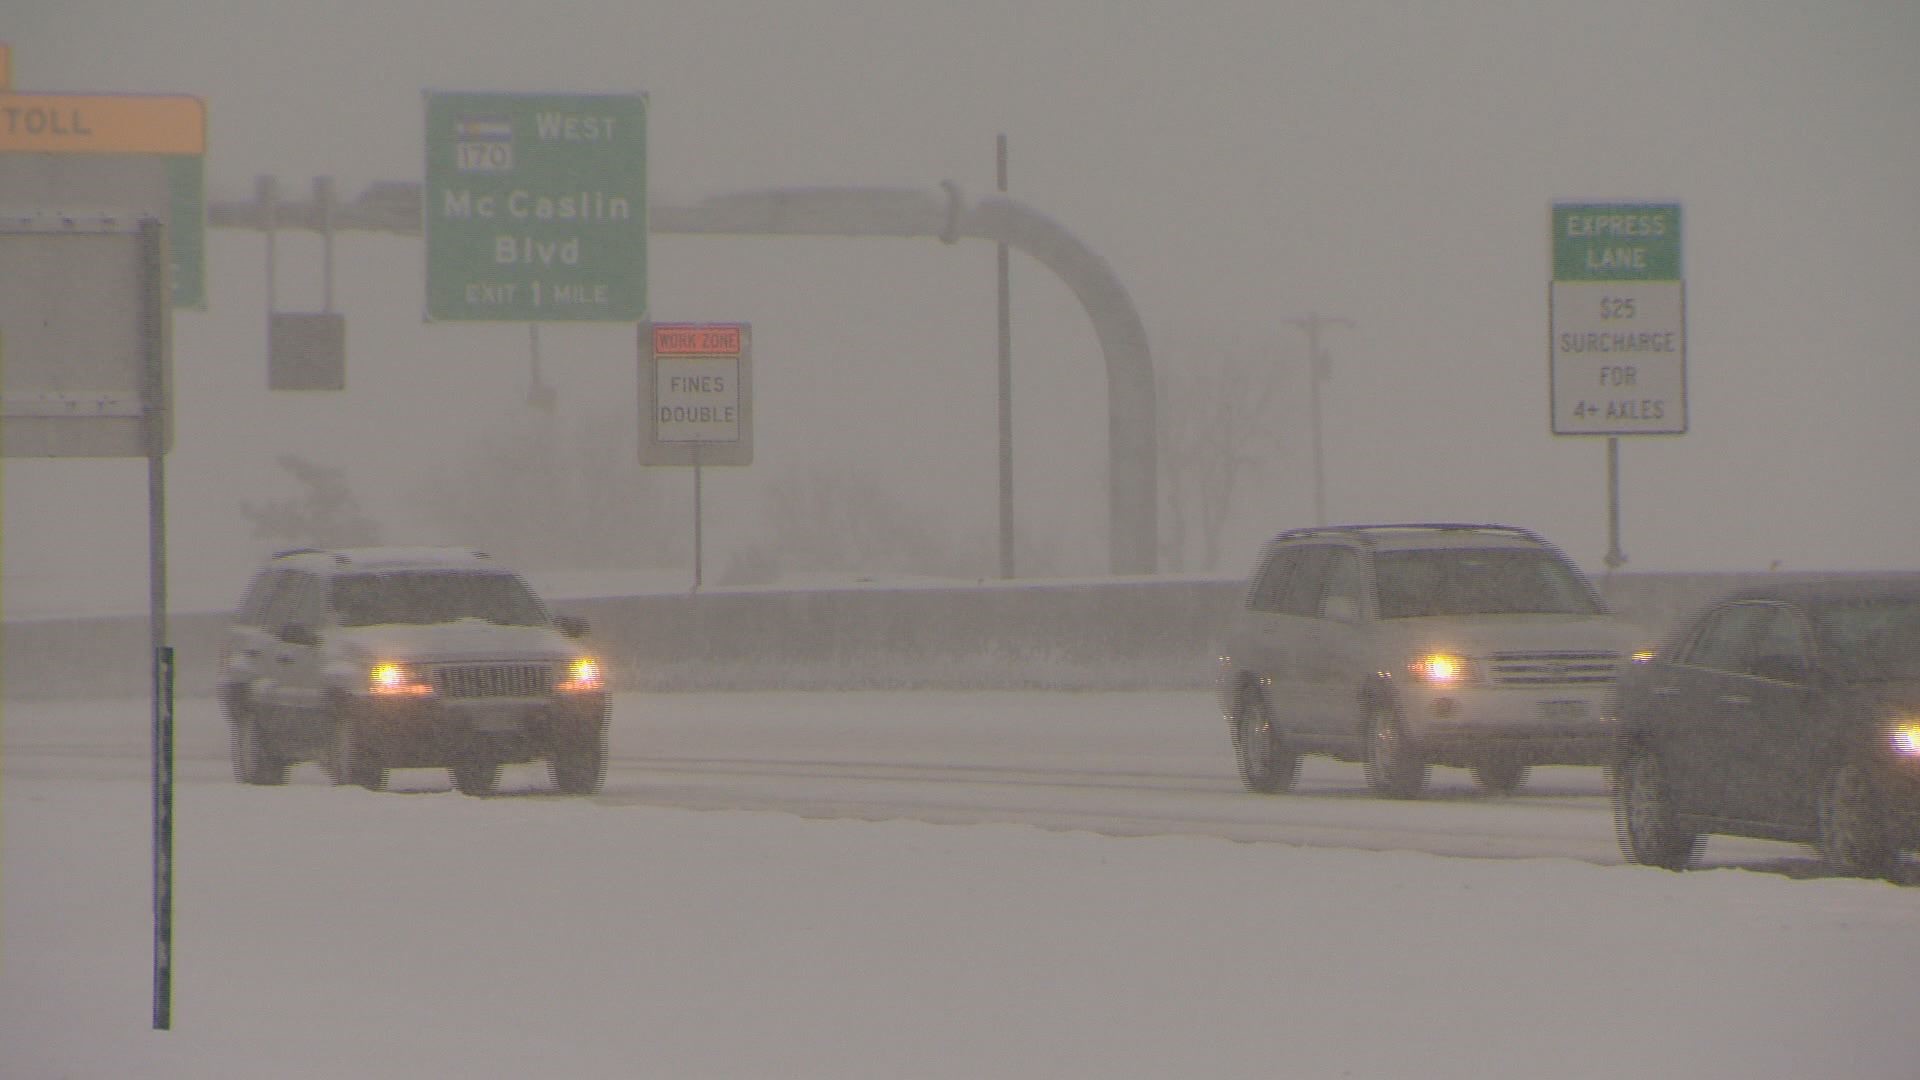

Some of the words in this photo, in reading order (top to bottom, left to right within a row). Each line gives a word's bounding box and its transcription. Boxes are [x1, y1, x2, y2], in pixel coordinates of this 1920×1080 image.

[4, 107, 92, 135] TOLL
[536, 112, 616, 140] WEST
[1567, 215, 1665, 236] EXPRESS
[496, 236, 579, 265] Blvd
[1586, 248, 1646, 269] LANE
[465, 284, 515, 304] EXIT
[532, 280, 542, 307] 1
[554, 285, 608, 303] MILE
[1600, 297, 1635, 319] $25
[660, 333, 696, 349] WORK
[703, 333, 735, 349] ZONE
[1561, 332, 1675, 353] SURCHARGE
[671, 376, 724, 392] FINES
[1600, 366, 1637, 386] FOR
[661, 406, 735, 423] DOUBLE
[1573, 400, 1600, 420] 4+
[1605, 400, 1664, 420] AXLES
